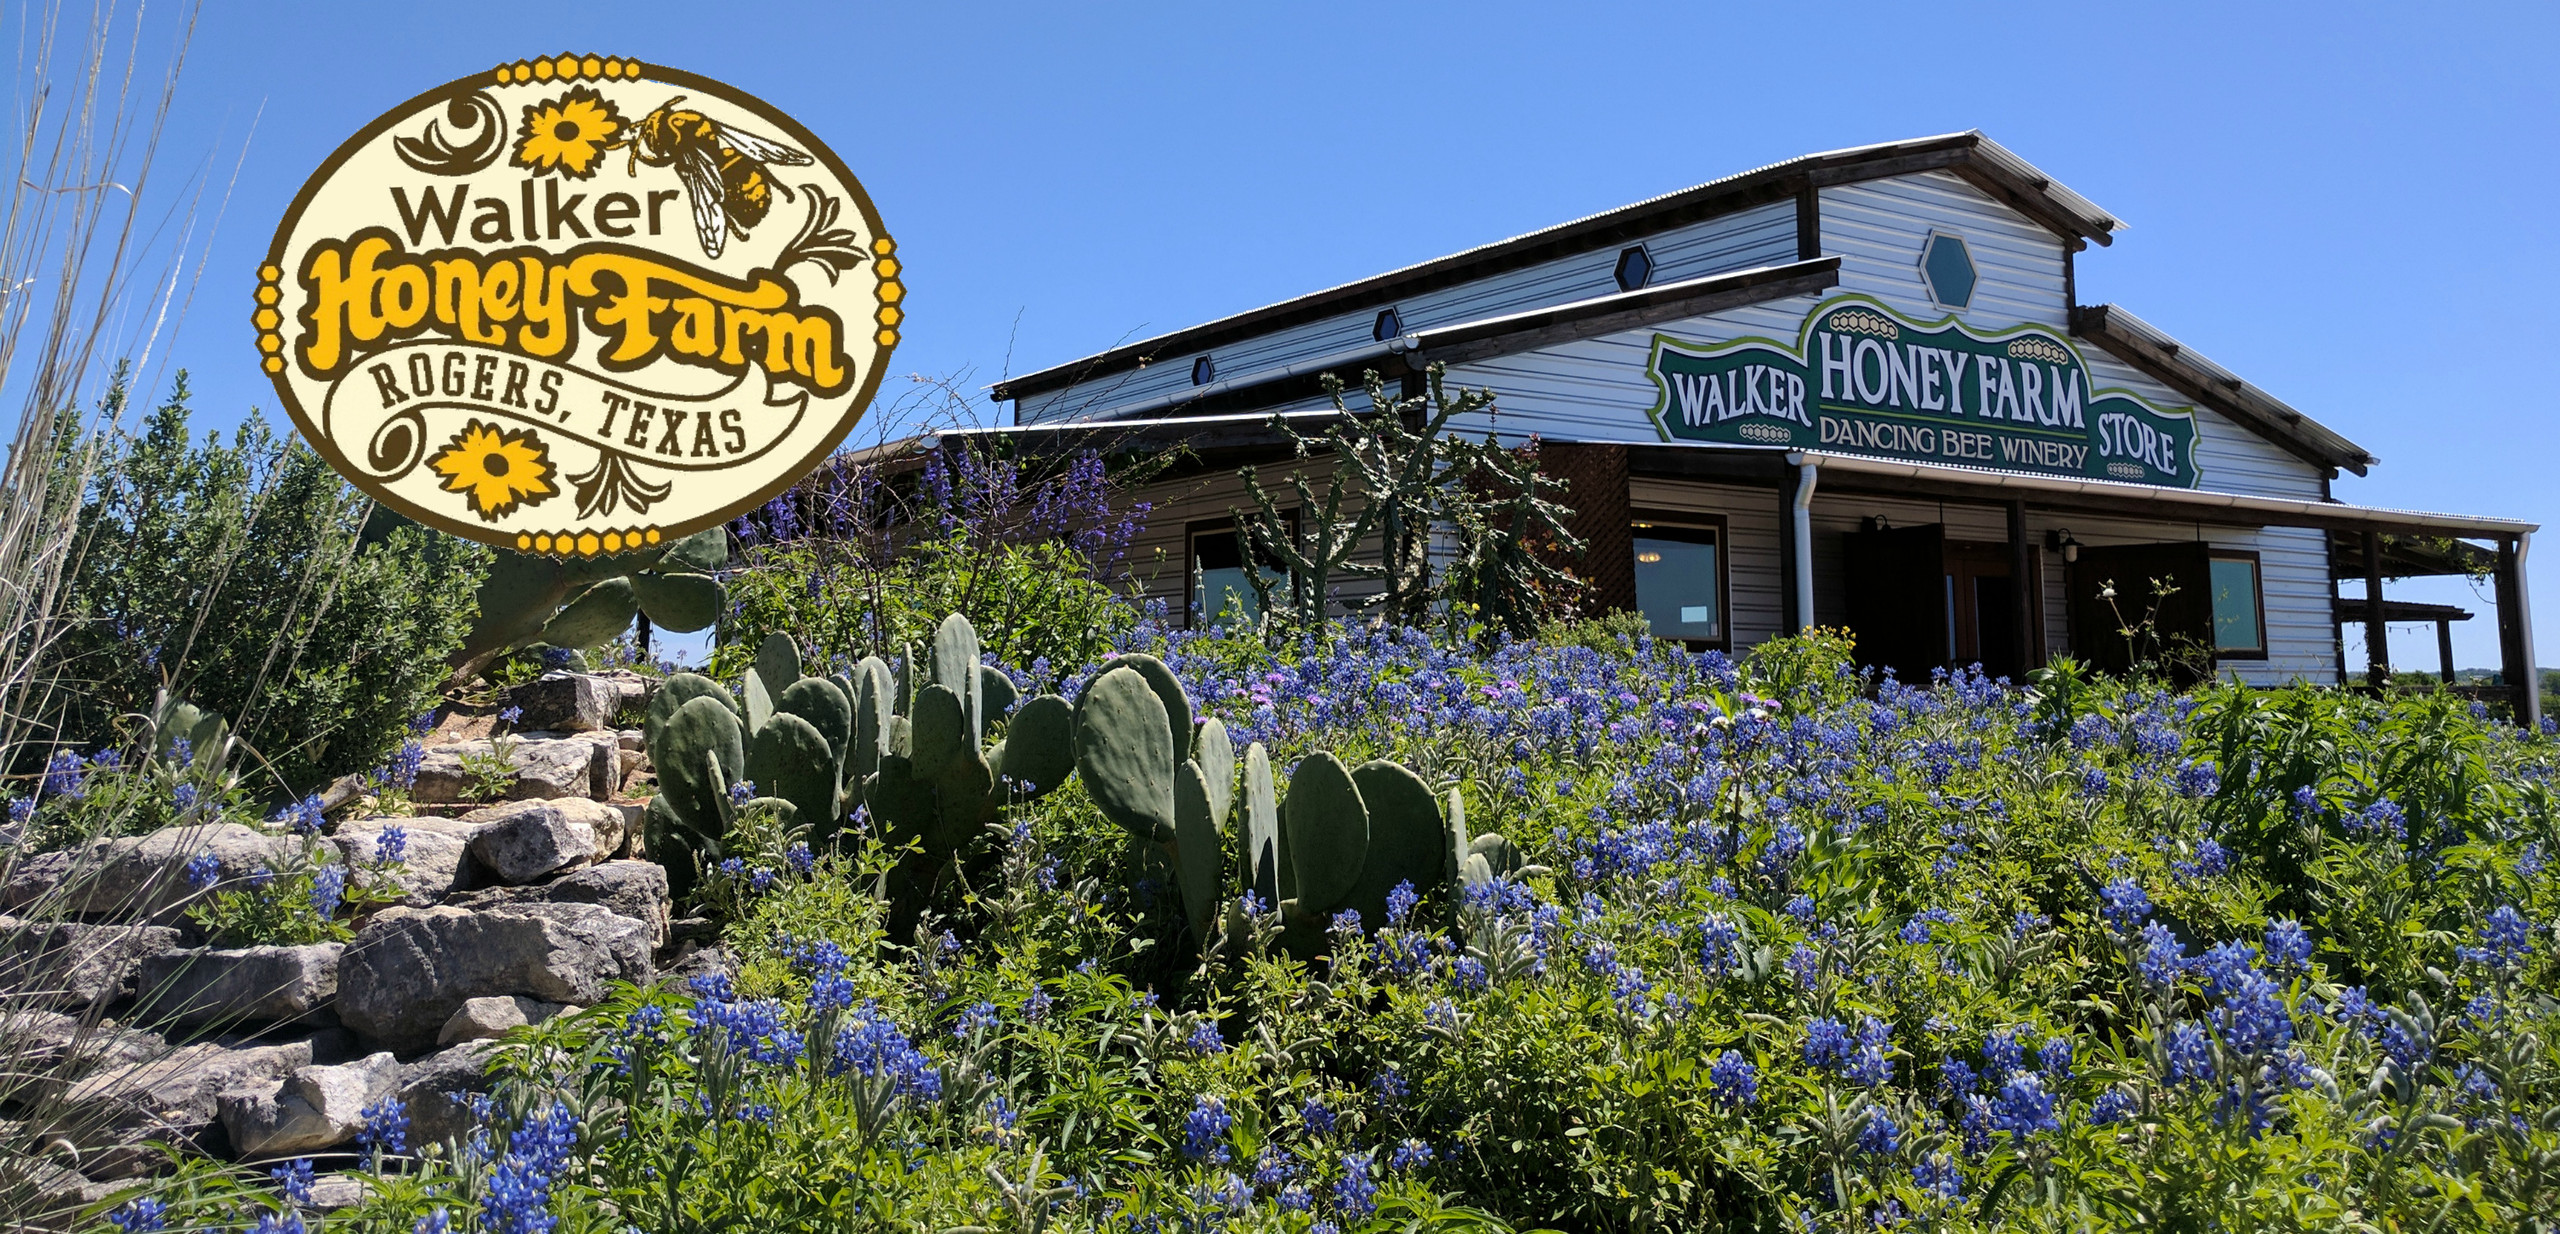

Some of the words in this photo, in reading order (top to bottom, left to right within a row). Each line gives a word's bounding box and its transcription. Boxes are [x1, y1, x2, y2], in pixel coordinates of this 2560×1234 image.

[1672, 364, 1813, 428] WALKER
[1818, 331, 1969, 415] HONEY
[1977, 356, 2084, 429] FARM
[2098, 412, 2178, 476] STORE
[1819, 416, 1936, 456] DANCING
[1942, 426, 1994, 461] BEE
[1998, 436, 2089, 470] WINERY
